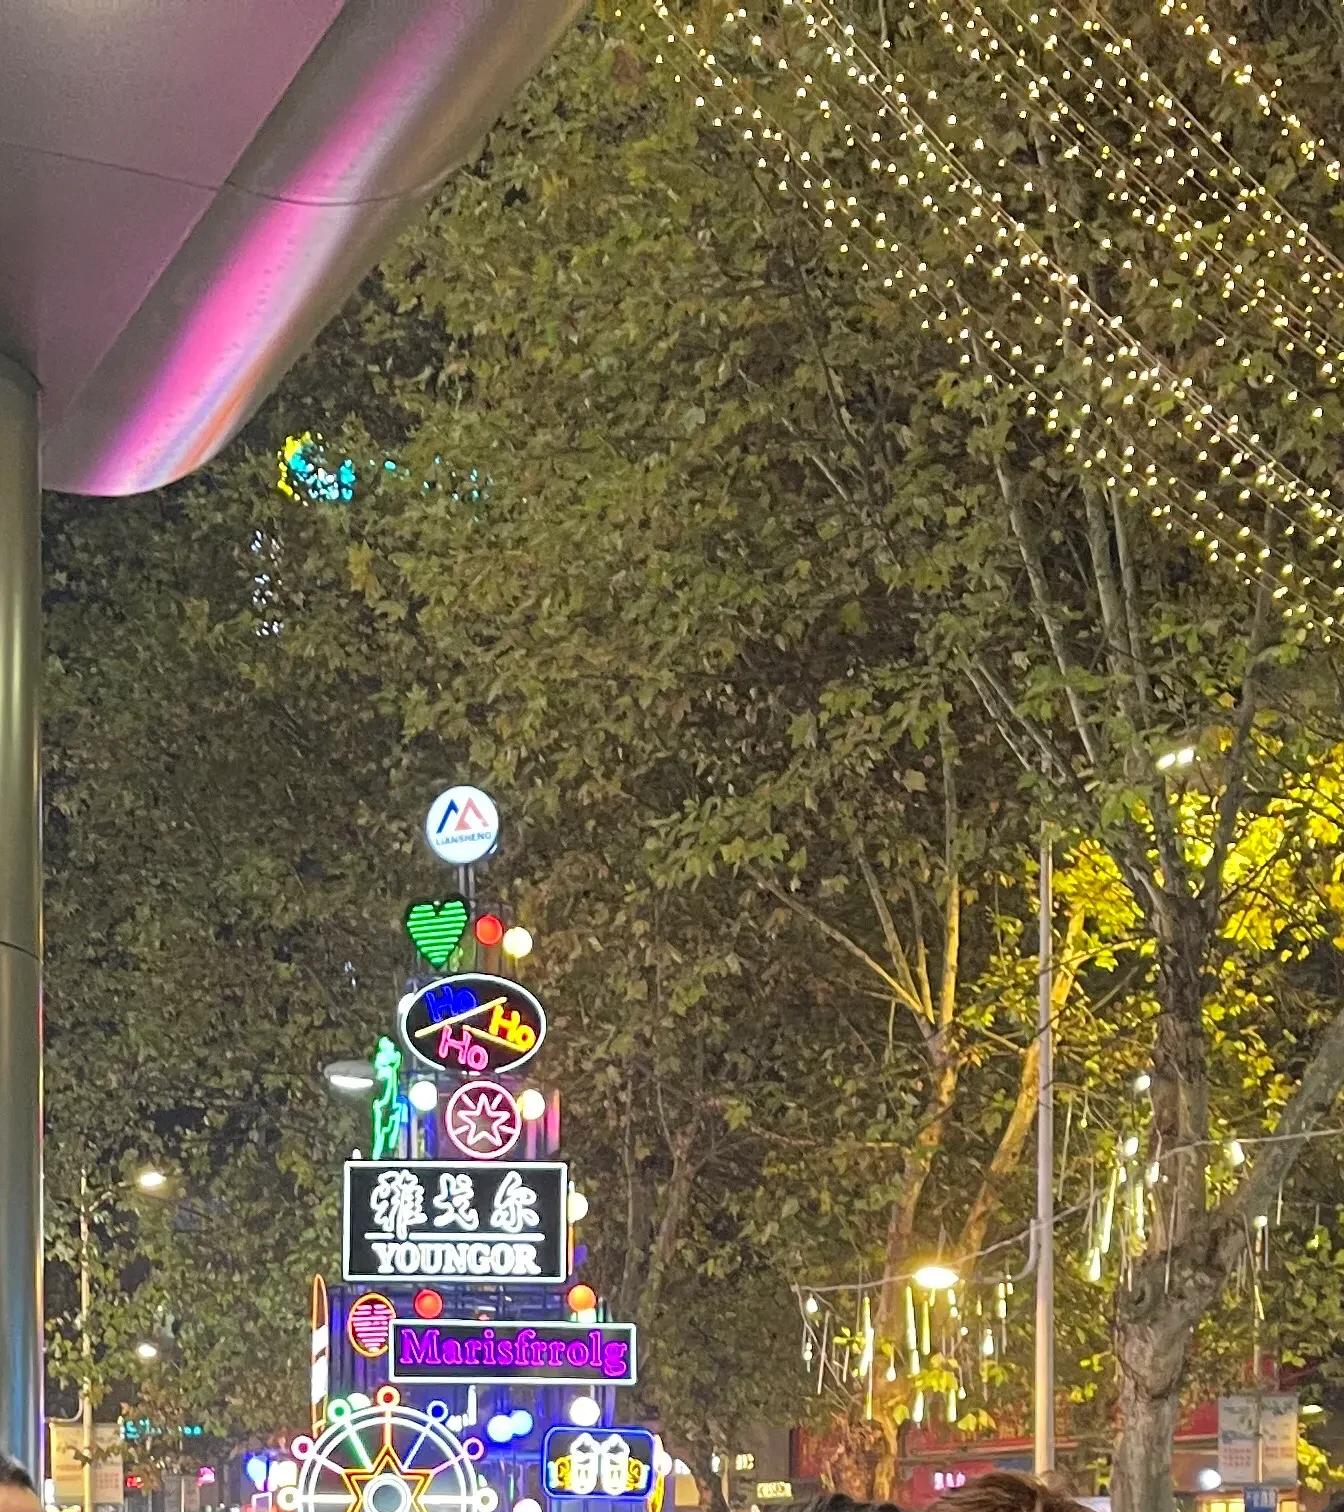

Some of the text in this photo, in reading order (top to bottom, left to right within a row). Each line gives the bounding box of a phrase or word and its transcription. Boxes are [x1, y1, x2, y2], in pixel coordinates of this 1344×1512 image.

[425, 984, 478, 1023] Ho
[488, 1003, 536, 1052] Ho
[437, 1024, 489, 1071] Ho
[369, 1168, 541, 1238] 雅戈尔
[371, 1242, 542, 1275] YOUNGOR
[400, 1328, 628, 1377] Marisfrrolg
